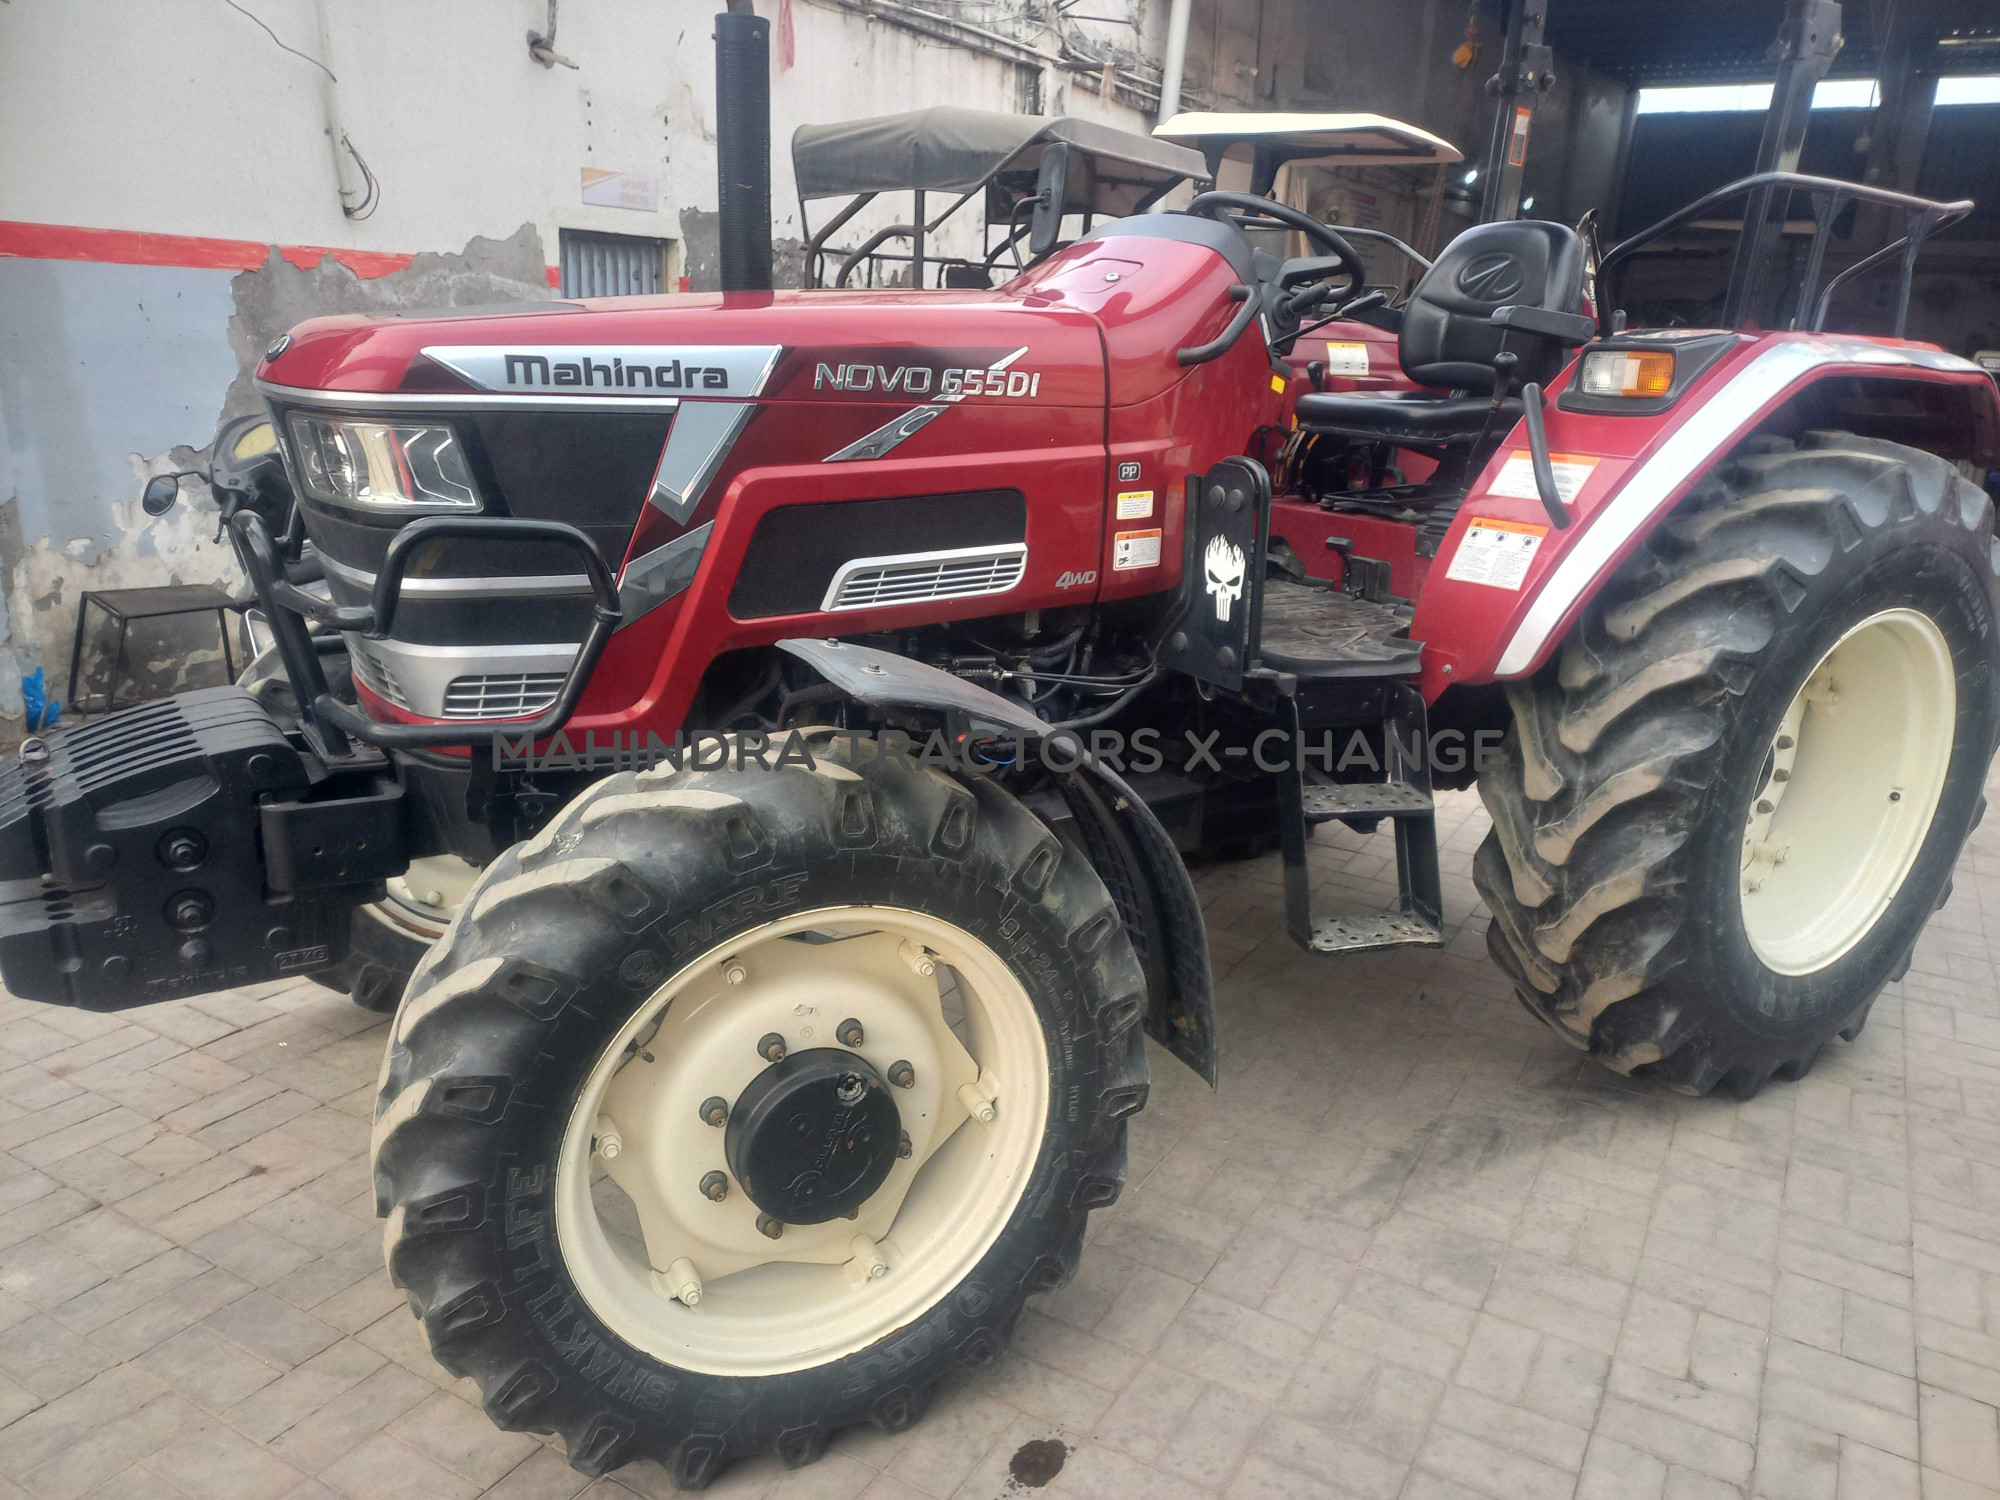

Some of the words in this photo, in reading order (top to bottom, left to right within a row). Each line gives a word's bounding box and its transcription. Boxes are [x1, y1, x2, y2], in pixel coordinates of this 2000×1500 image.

[504, 354, 728, 389] Mahindra
[814, 363, 932, 393] NOVO
[941, 368, 1041, 398] 655DI
[1121, 465, 1138, 479] PP
[1055, 570, 1097, 590] 4WD
[667, 871, 809, 960] MRF
[506, 1163, 551, 1282] LIFE
